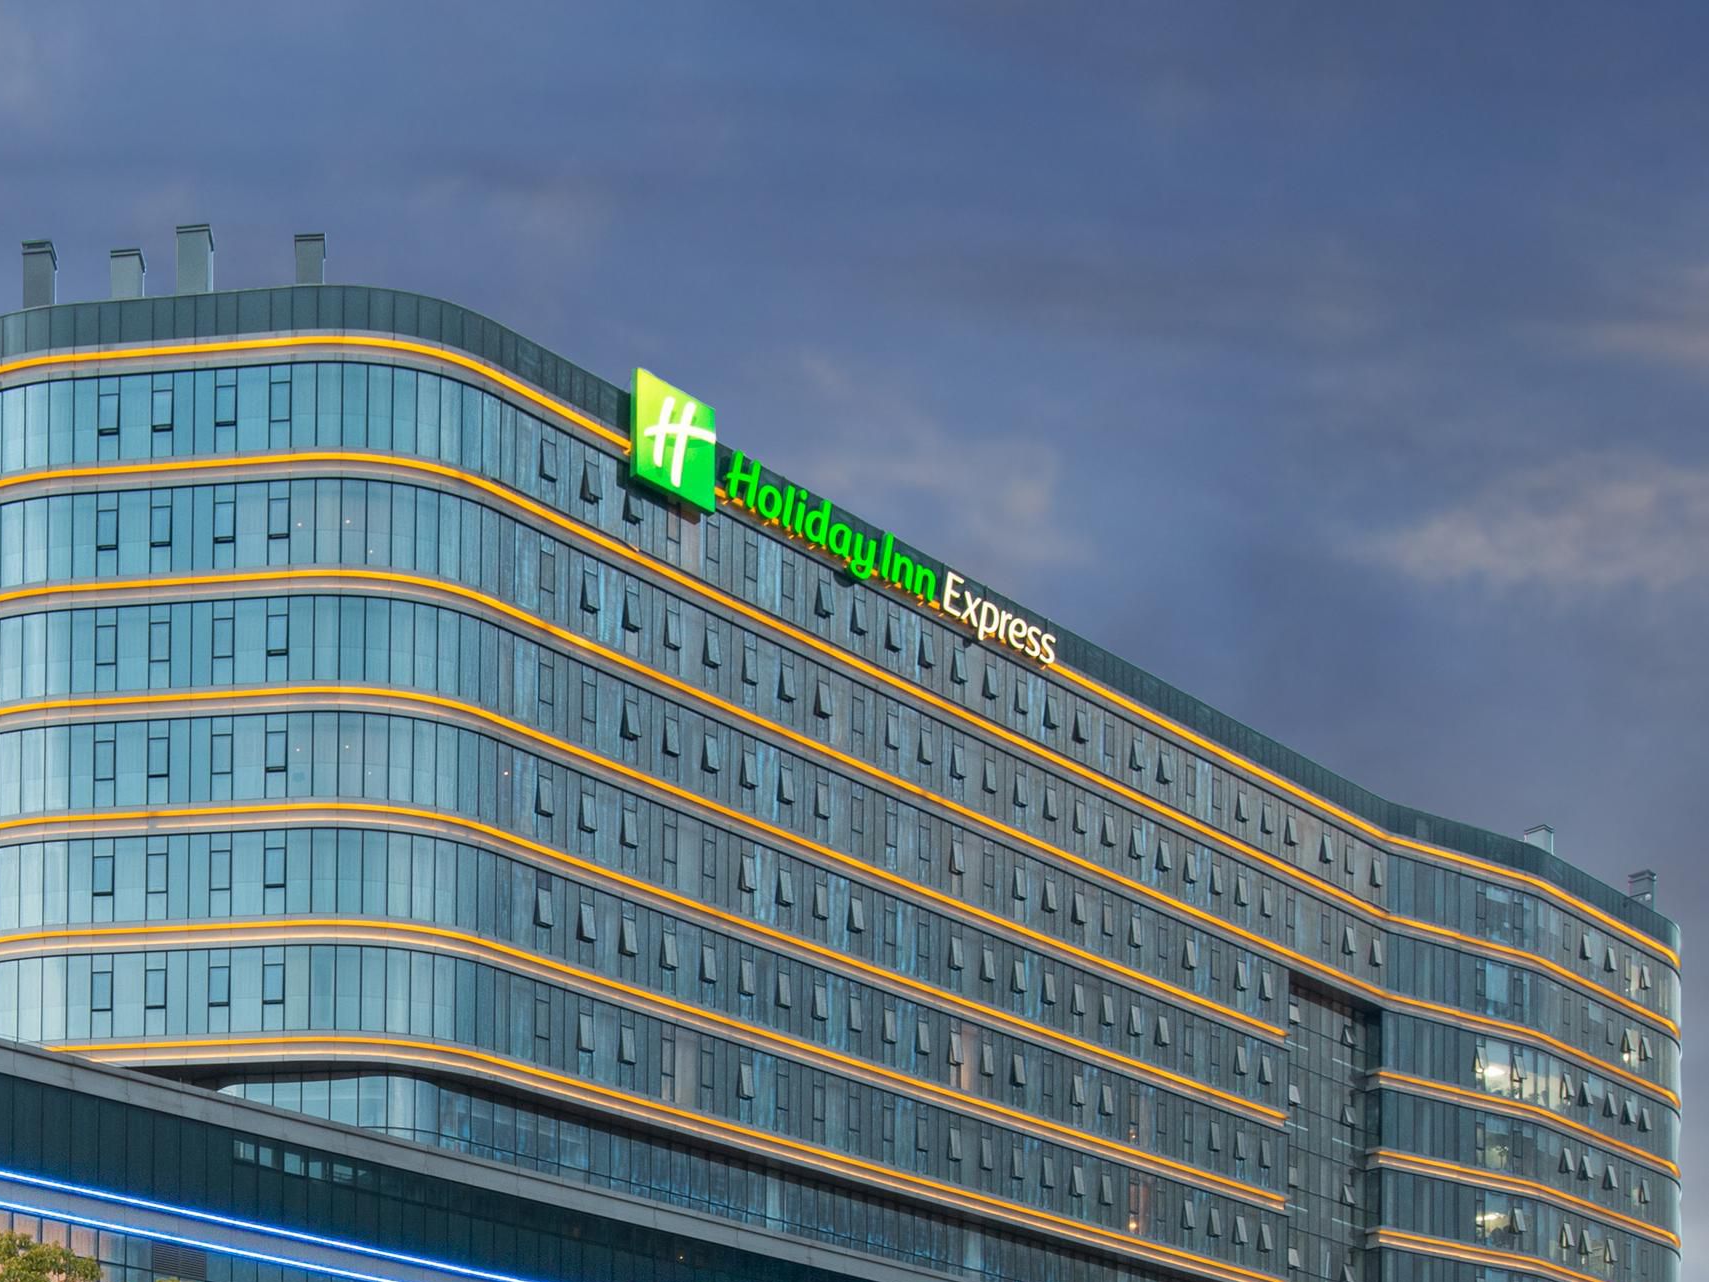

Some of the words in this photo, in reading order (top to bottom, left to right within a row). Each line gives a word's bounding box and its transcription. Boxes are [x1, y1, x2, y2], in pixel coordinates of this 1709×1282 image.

[726, 450, 878, 581] Holiday
[878, 531, 937, 602] Inn
[942, 571, 1057, 665] Express
